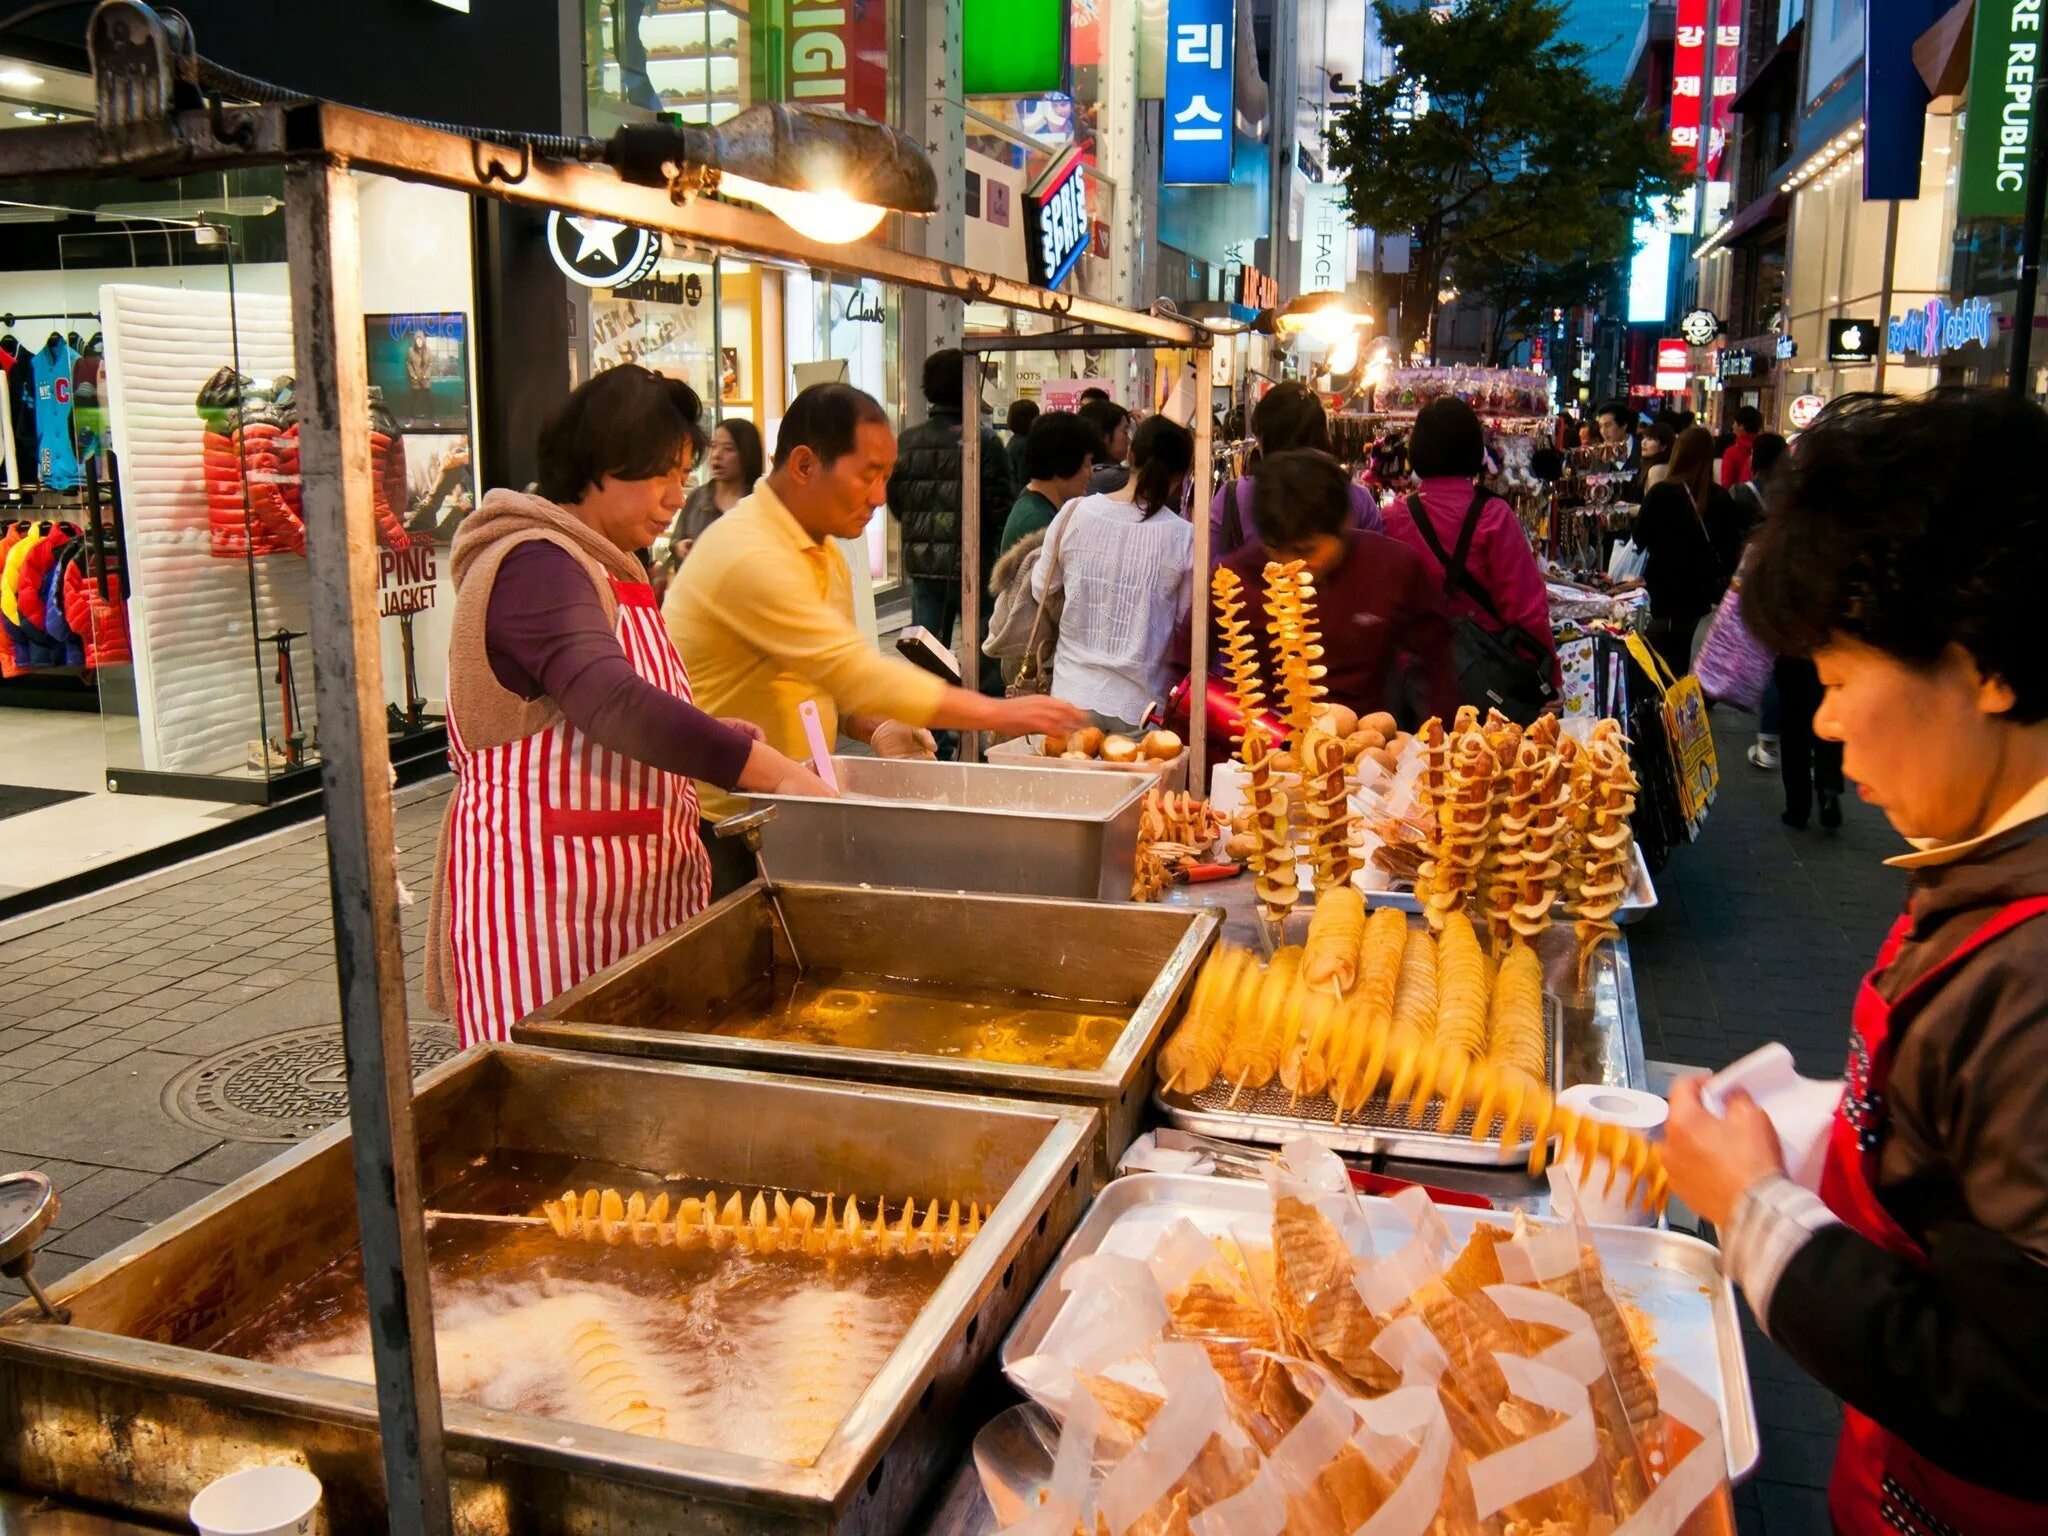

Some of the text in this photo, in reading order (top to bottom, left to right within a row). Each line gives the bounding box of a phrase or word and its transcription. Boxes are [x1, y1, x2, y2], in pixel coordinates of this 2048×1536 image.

[1996, 43, 2037, 192] REPUBLIC
[1040, 163, 1089, 279] SPRIS
[846, 289, 886, 324] Clarks
[376, 546, 437, 590] PING
[380, 584, 437, 618] JACKET
